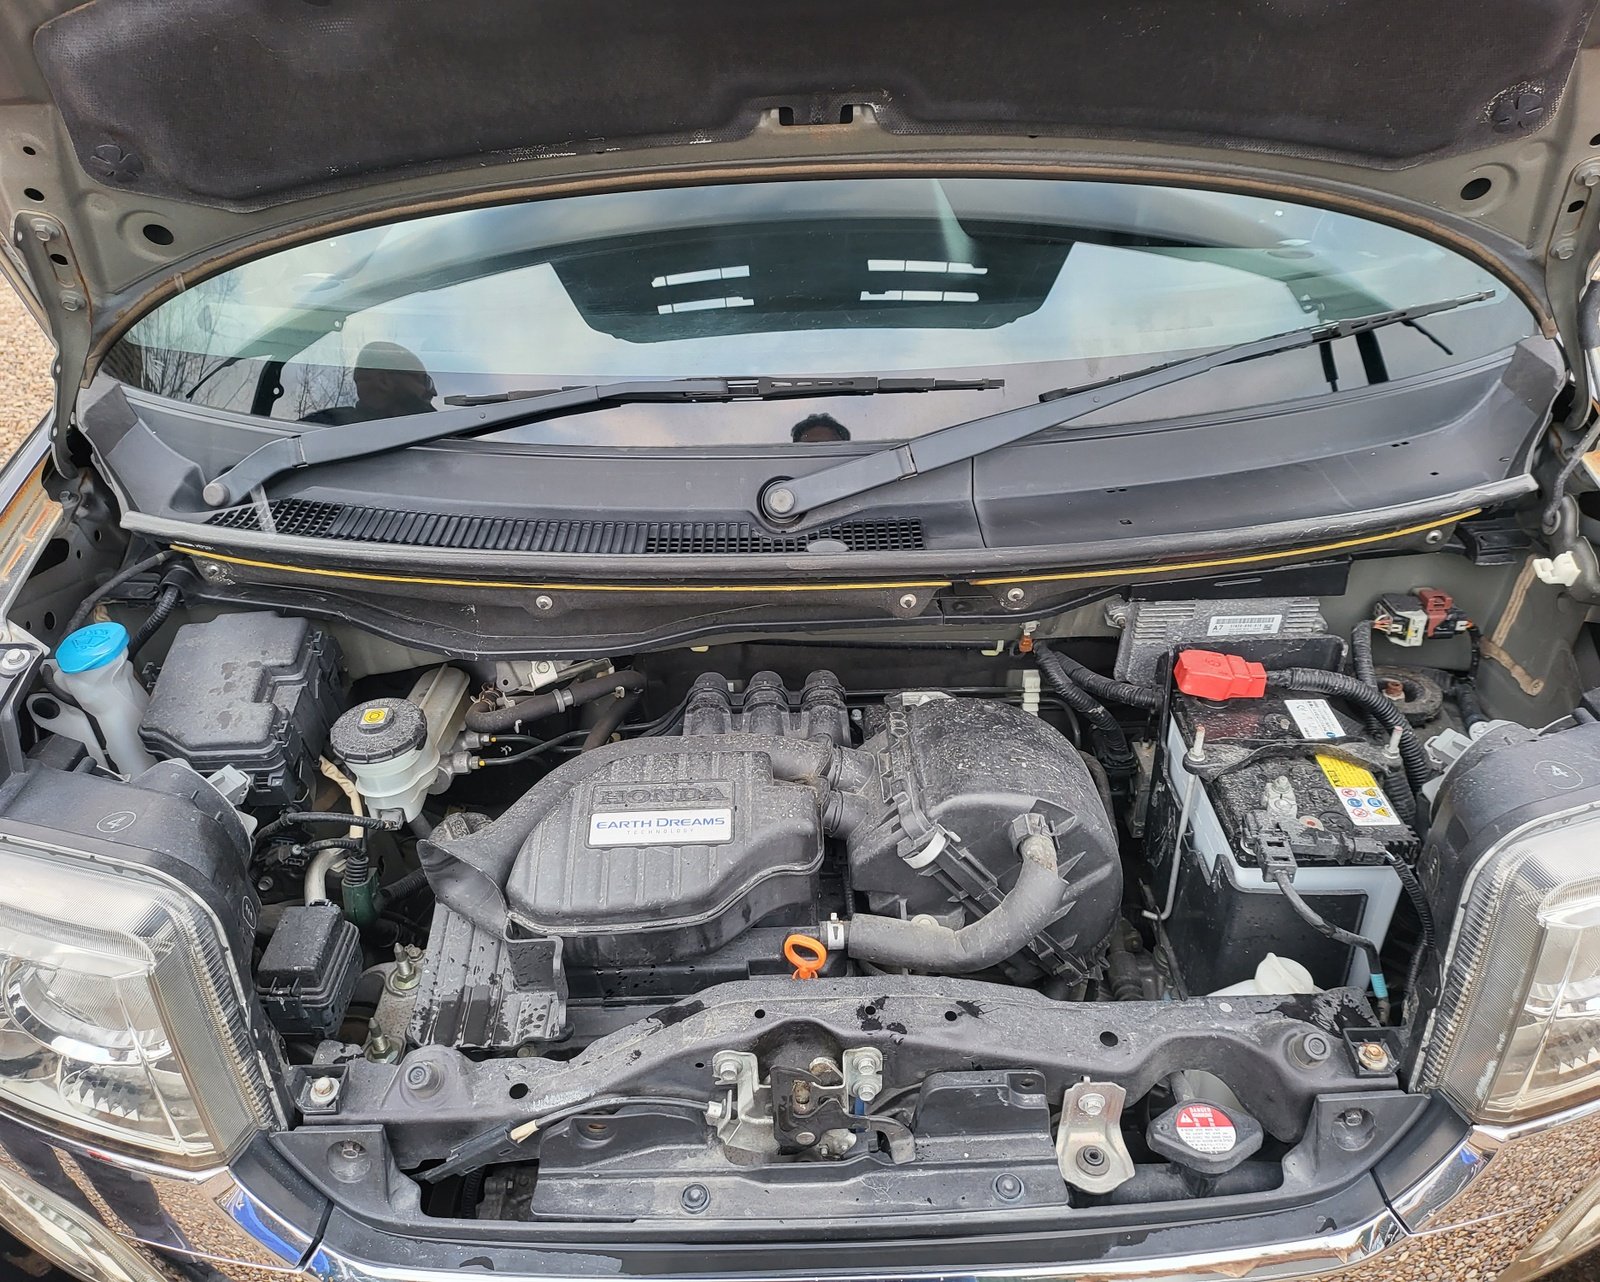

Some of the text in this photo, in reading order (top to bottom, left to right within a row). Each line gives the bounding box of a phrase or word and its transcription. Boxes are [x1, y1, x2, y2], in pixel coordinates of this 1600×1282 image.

[599, 787, 728, 804] HONDA
[596, 817, 725, 829] EARTH DREAMS
